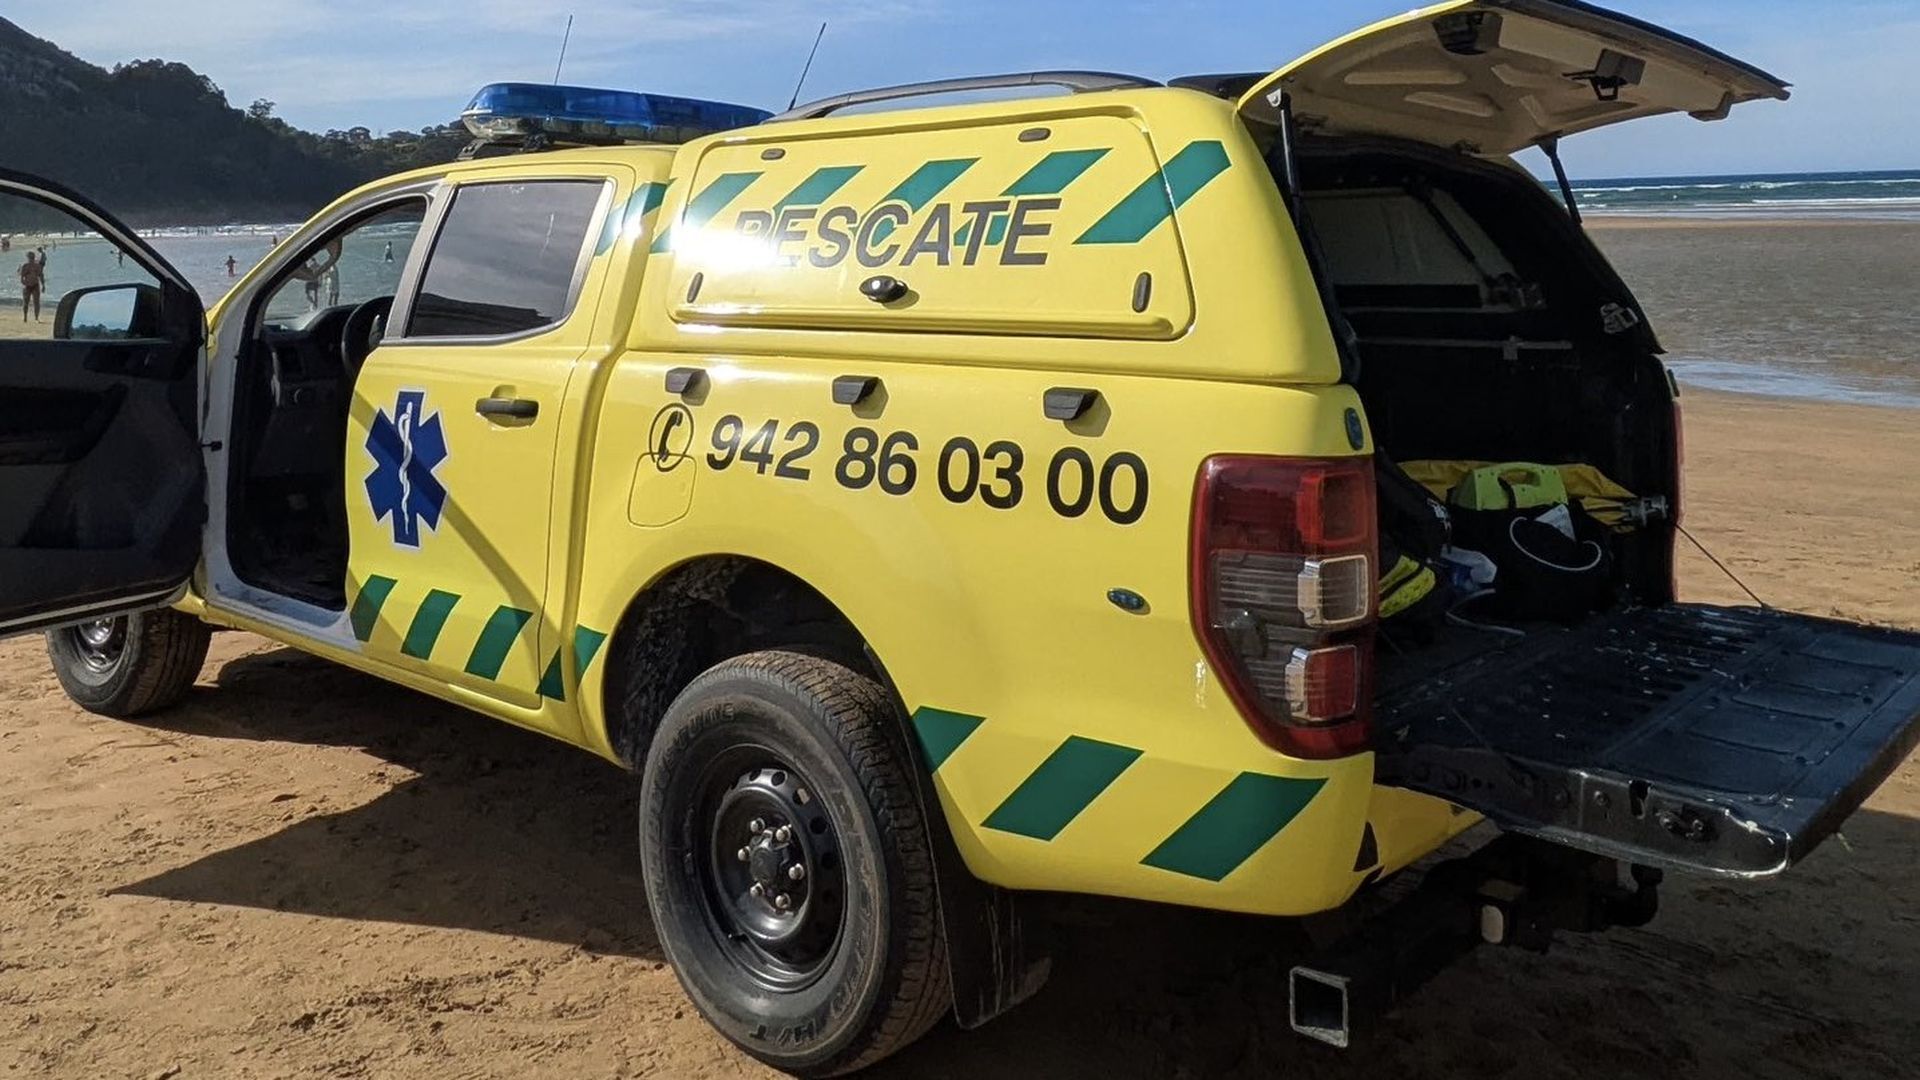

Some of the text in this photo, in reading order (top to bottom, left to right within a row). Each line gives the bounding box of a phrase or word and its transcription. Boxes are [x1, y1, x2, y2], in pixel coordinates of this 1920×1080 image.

[706, 414, 1149, 525] 942 86 03 00
